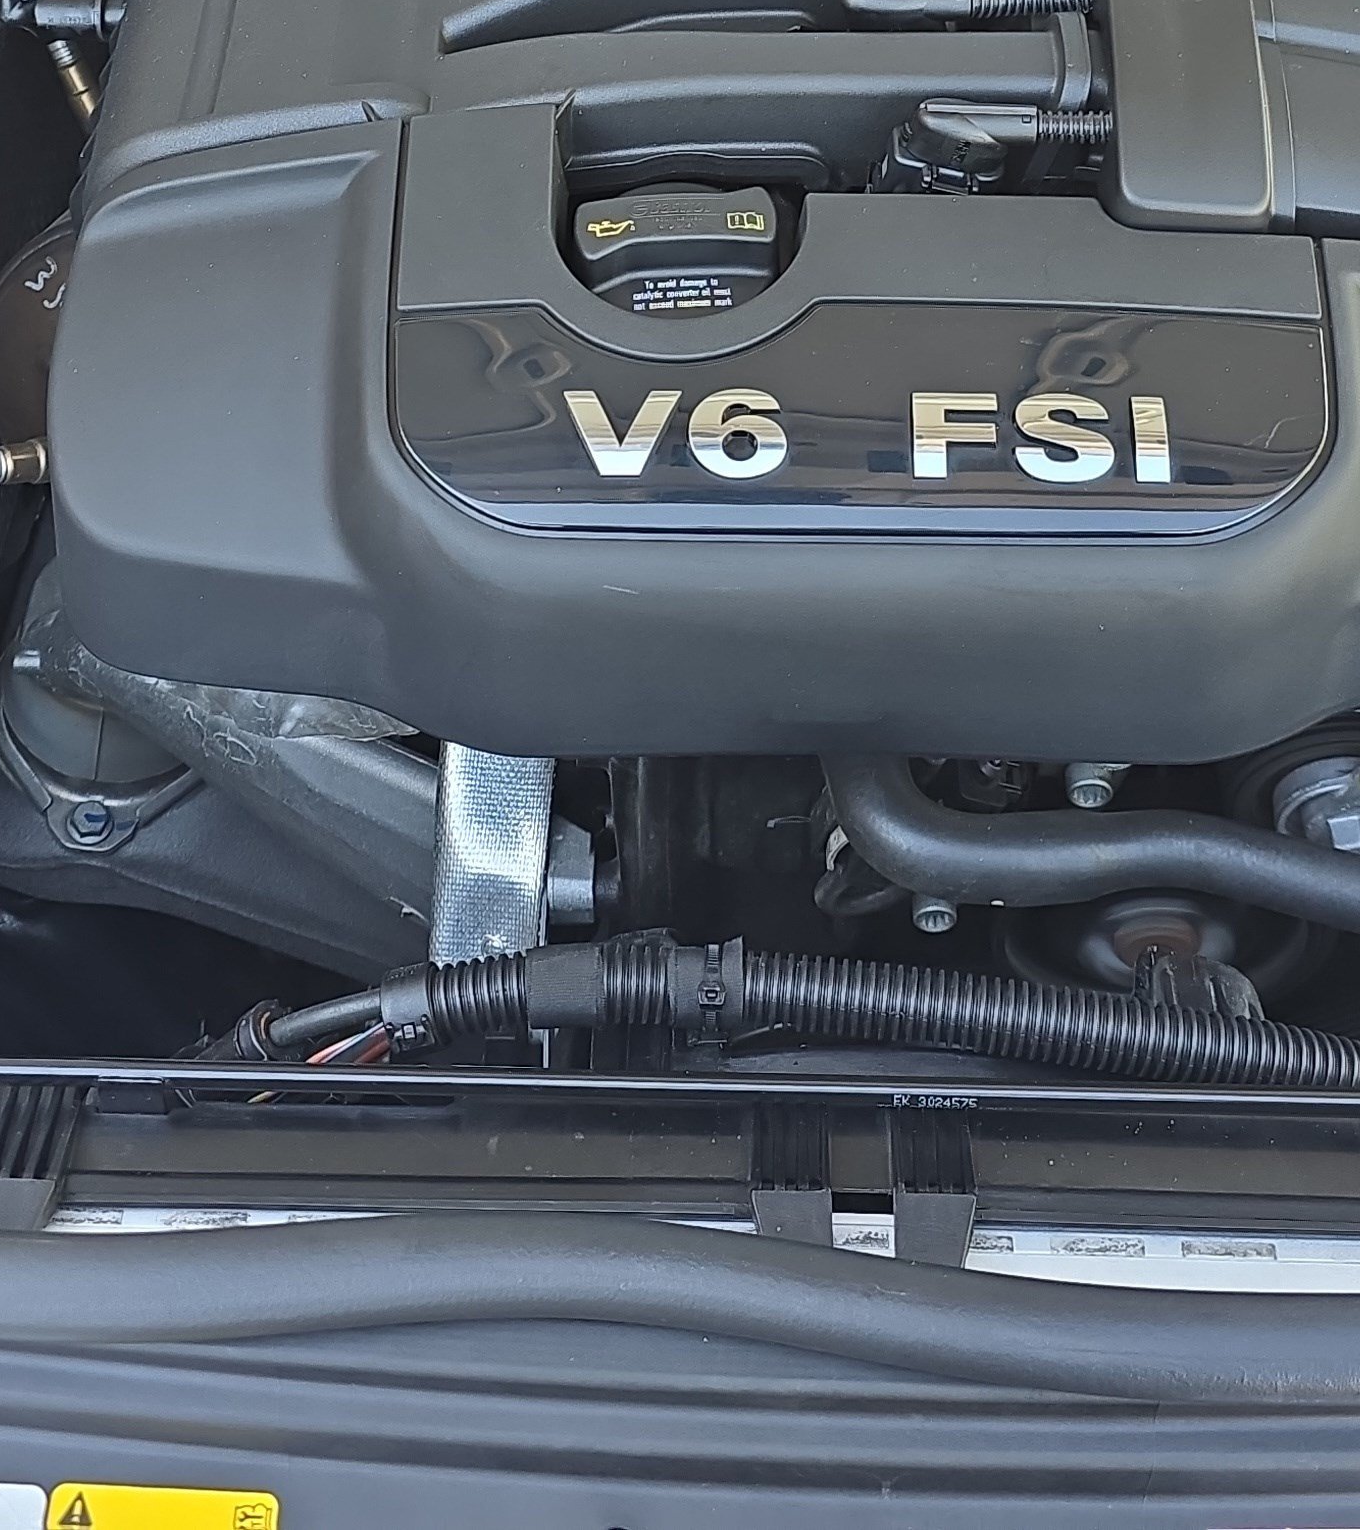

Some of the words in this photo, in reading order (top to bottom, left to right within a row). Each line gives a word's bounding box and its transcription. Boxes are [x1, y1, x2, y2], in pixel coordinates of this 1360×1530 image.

[643, 280, 654, 289] To
[656, 278, 677, 289] avoid
[679, 277, 708, 289] damage
[632, 290, 664, 301] catalytic
[666, 288, 700, 299] converter
[633, 301, 646, 311] not
[714, 297, 733, 307] mark
[563, 387, 788, 480] V6
[910, 390, 1173, 485] FSI
